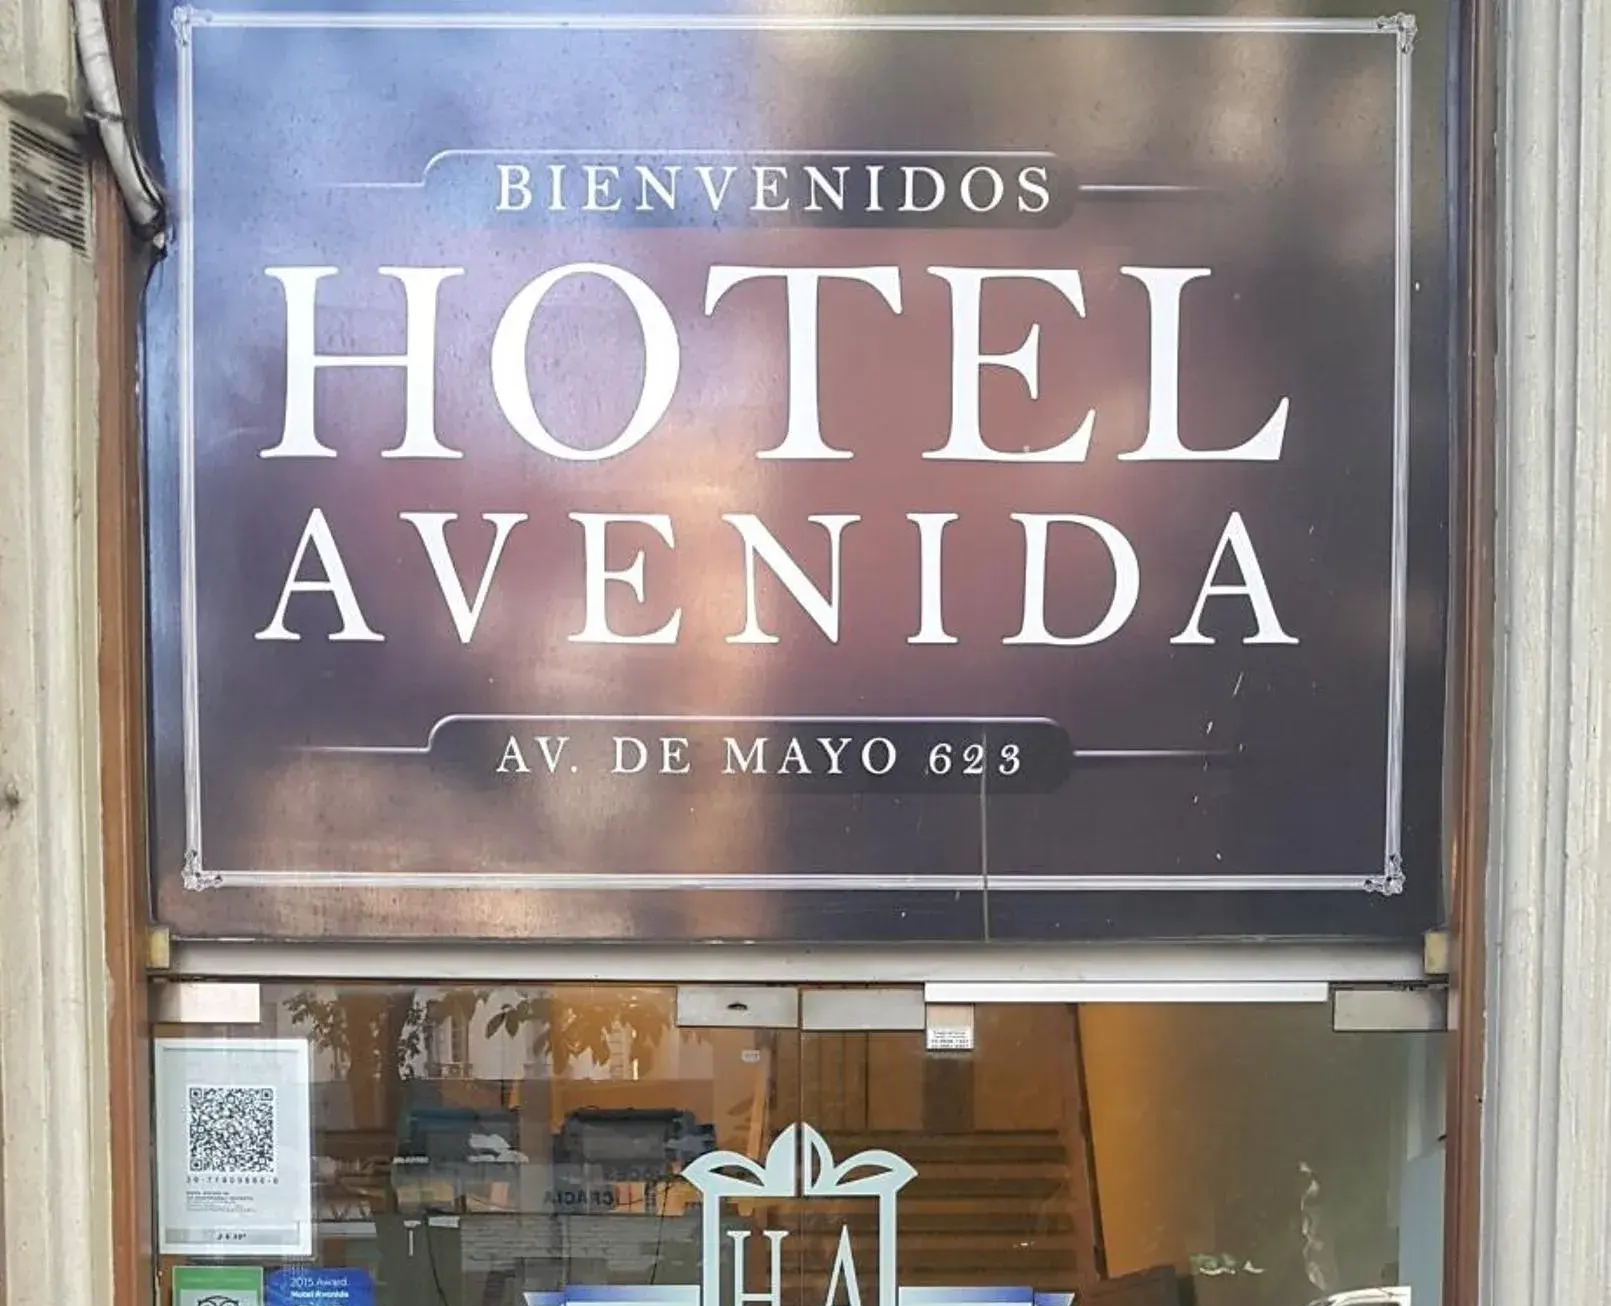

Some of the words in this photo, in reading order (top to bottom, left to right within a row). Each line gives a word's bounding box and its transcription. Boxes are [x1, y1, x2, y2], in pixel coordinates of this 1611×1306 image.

[495, 163, 1051, 214] BIENVENIDOS
[259, 262, 1290, 463] HOTEL
[255, 507, 1300, 648] AVENIDA
[496, 736, 578, 775] AV.
[612, 737, 691, 774] DE
[723, 737, 897, 776] MAYO
[929, 743, 1022, 776] 623
[290, 1276, 314, 1287] 2015
[316, 1277, 348, 1287] Award
